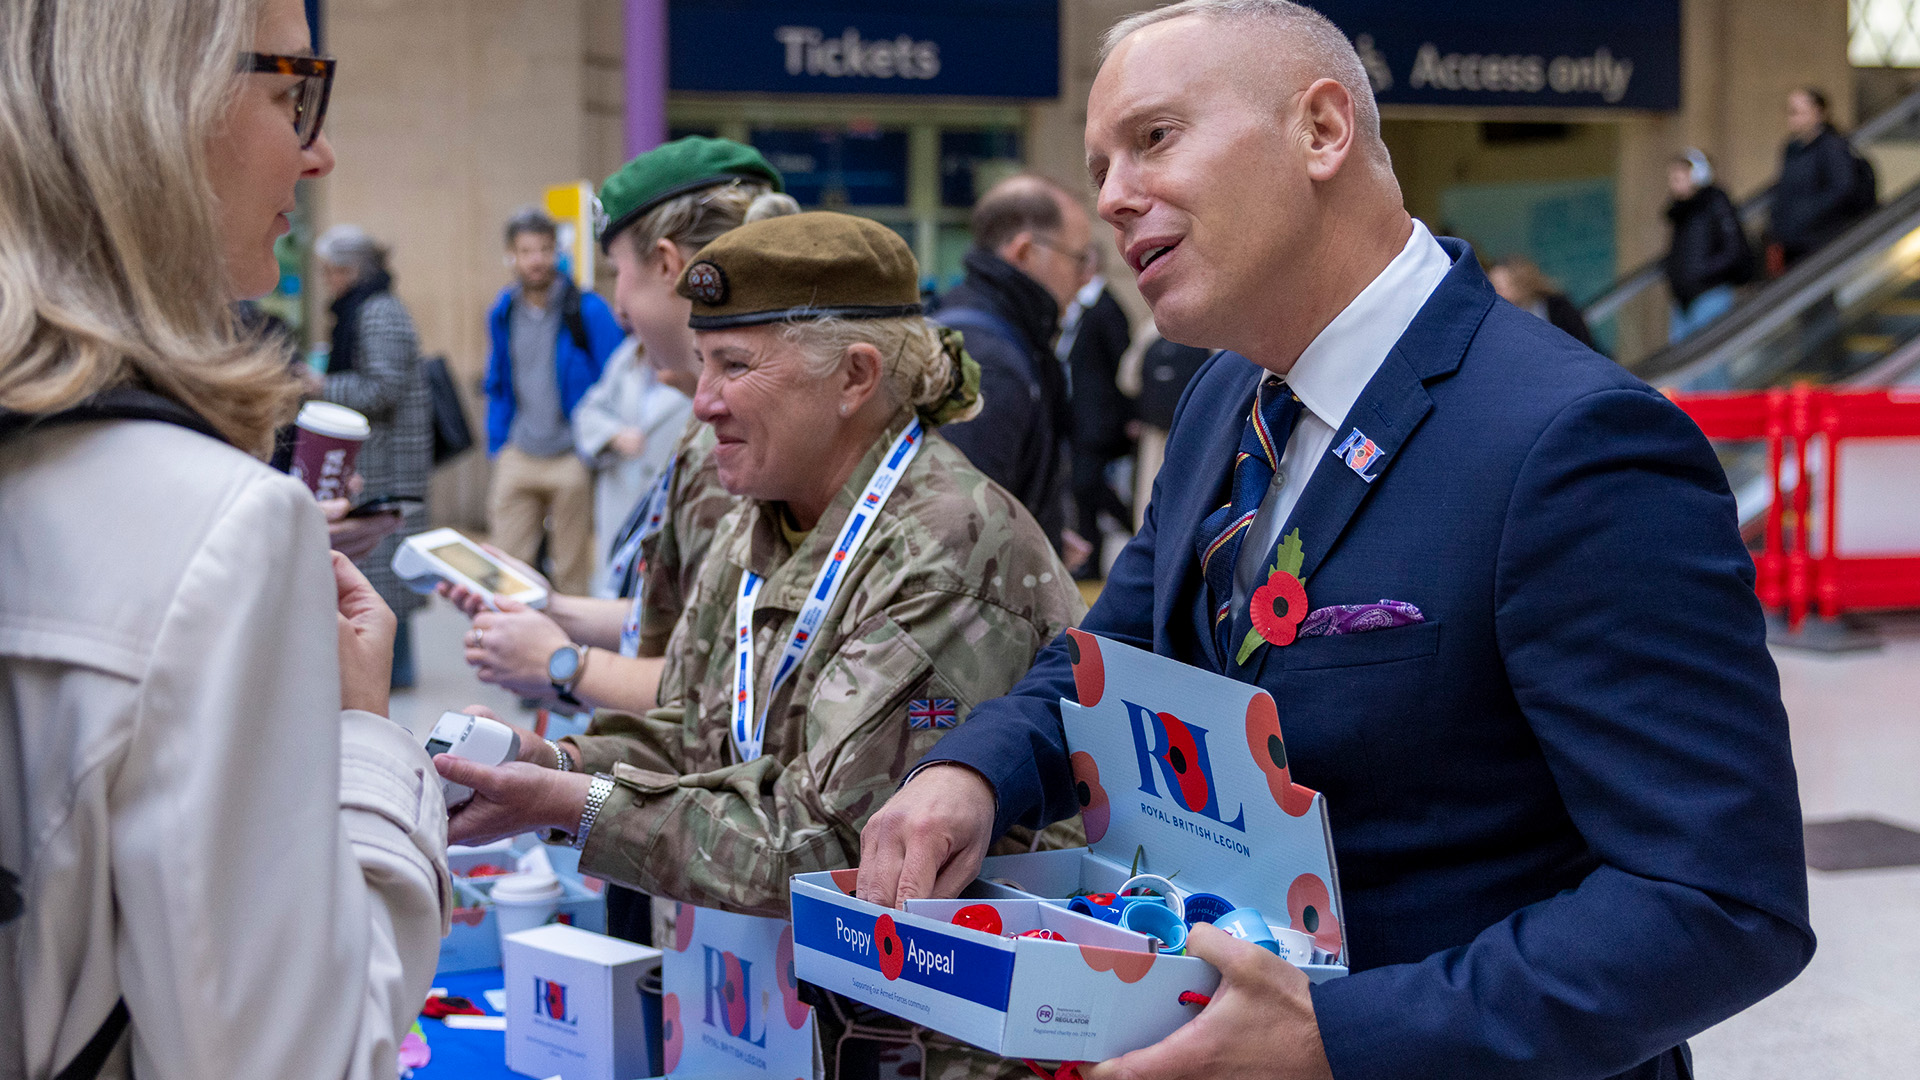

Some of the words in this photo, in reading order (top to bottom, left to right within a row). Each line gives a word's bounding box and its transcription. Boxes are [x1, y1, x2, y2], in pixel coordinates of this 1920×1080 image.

[774, 26, 941, 79] Tickets
[1409, 43, 1546, 92] Access
[1549, 48, 1634, 103] only
[1141, 803, 1170, 824] ROYAL
[1173, 815, 1211, 841] BRITISH
[1213, 832, 1250, 858] LEGION
[836, 917, 871, 956] Poppy
[907, 938, 955, 975] Appeal
[1040, 1010, 1051, 1018] FR
